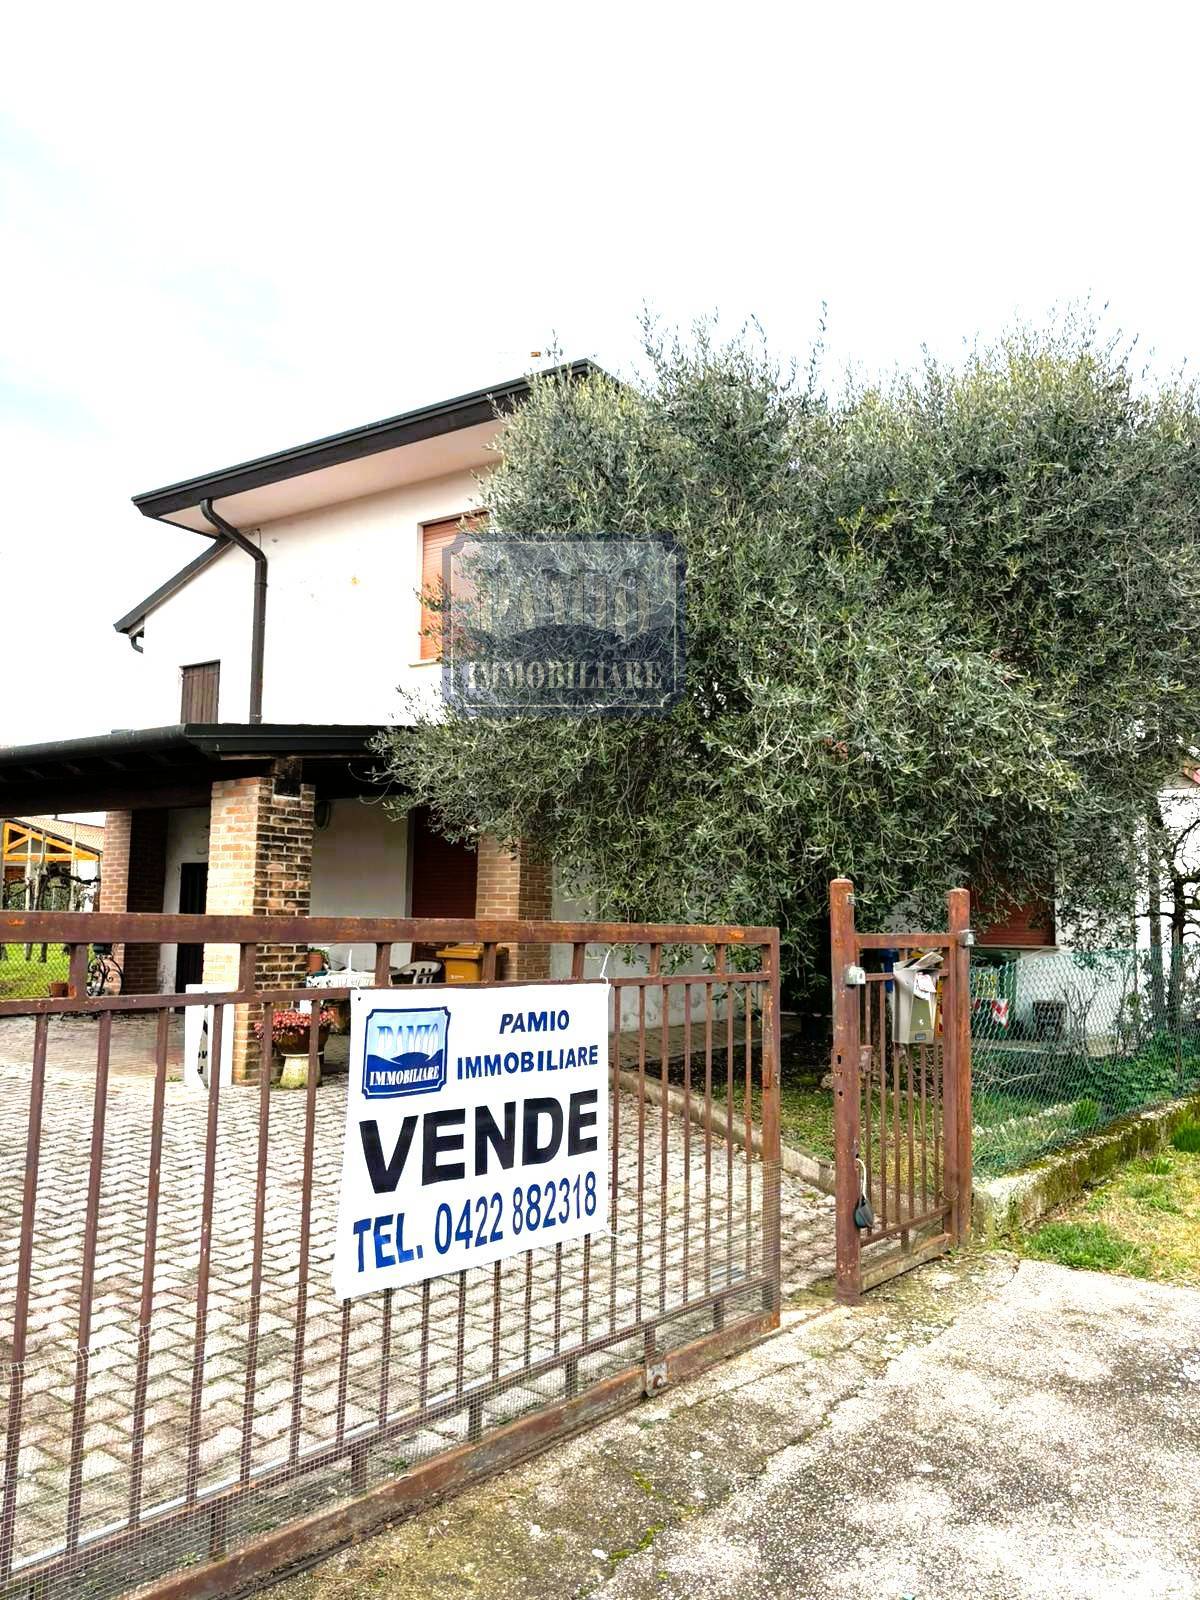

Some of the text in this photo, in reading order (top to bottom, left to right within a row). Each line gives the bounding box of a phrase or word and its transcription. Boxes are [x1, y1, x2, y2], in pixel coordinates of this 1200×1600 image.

[499, 1010, 570, 1034] PAMIO
[369, 1066, 440, 1086] IMMOBILIARE
[457, 1045, 598, 1079] IMMOBILIARE
[359, 1089, 598, 1194] VENDE
[353, 1171, 597, 1273] TEL. 0422 882318
